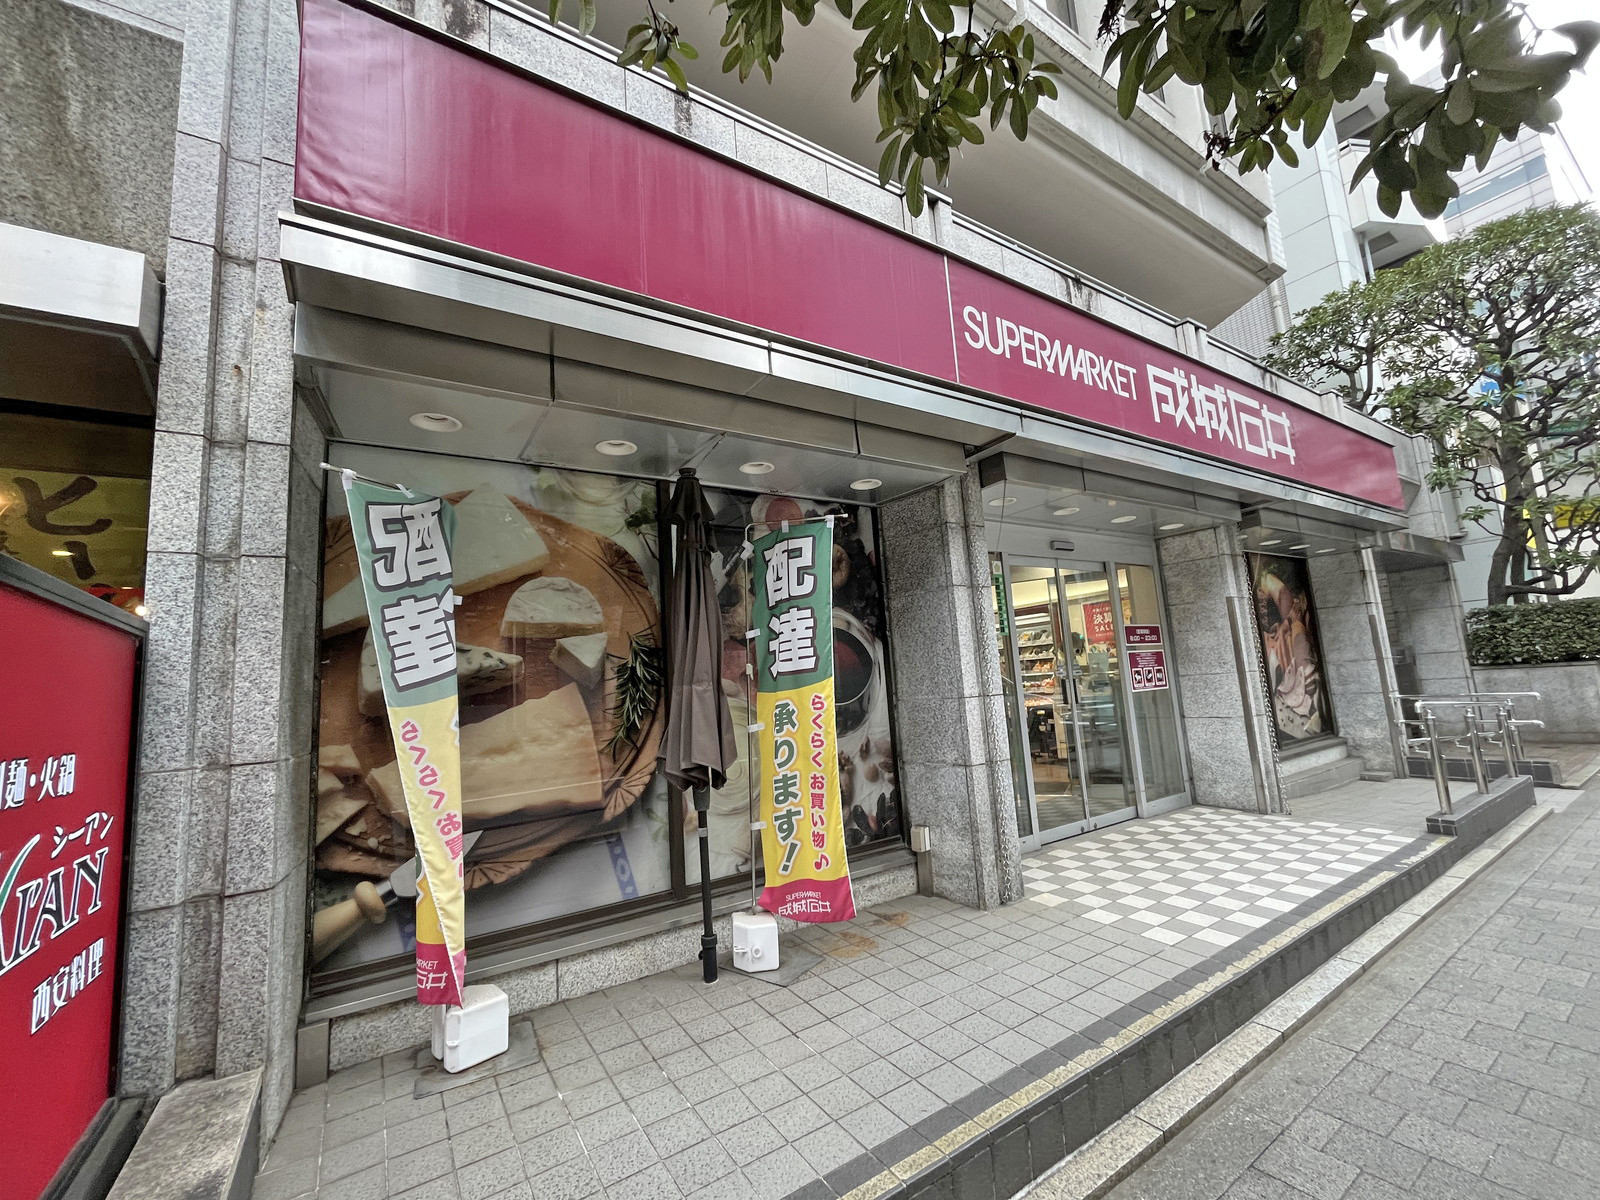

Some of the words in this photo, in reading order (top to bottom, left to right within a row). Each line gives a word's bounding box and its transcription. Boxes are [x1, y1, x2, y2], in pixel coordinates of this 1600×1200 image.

[963, 305, 1137, 400] SUPERMARKET
[1146, 363, 1296, 465] 成城石井
[764, 536, 817, 678] 配達
[811, 694, 825, 768] らくらく
[774, 702, 802, 872] 承ります!
[810, 774, 826, 849] お買い物
[51, 812, 114, 858] シーアン
[778, 899, 832, 916] 成城石井
[785, 891, 821, 902] SUPERMARKET
[31, 938, 104, 1035] 西安料理
